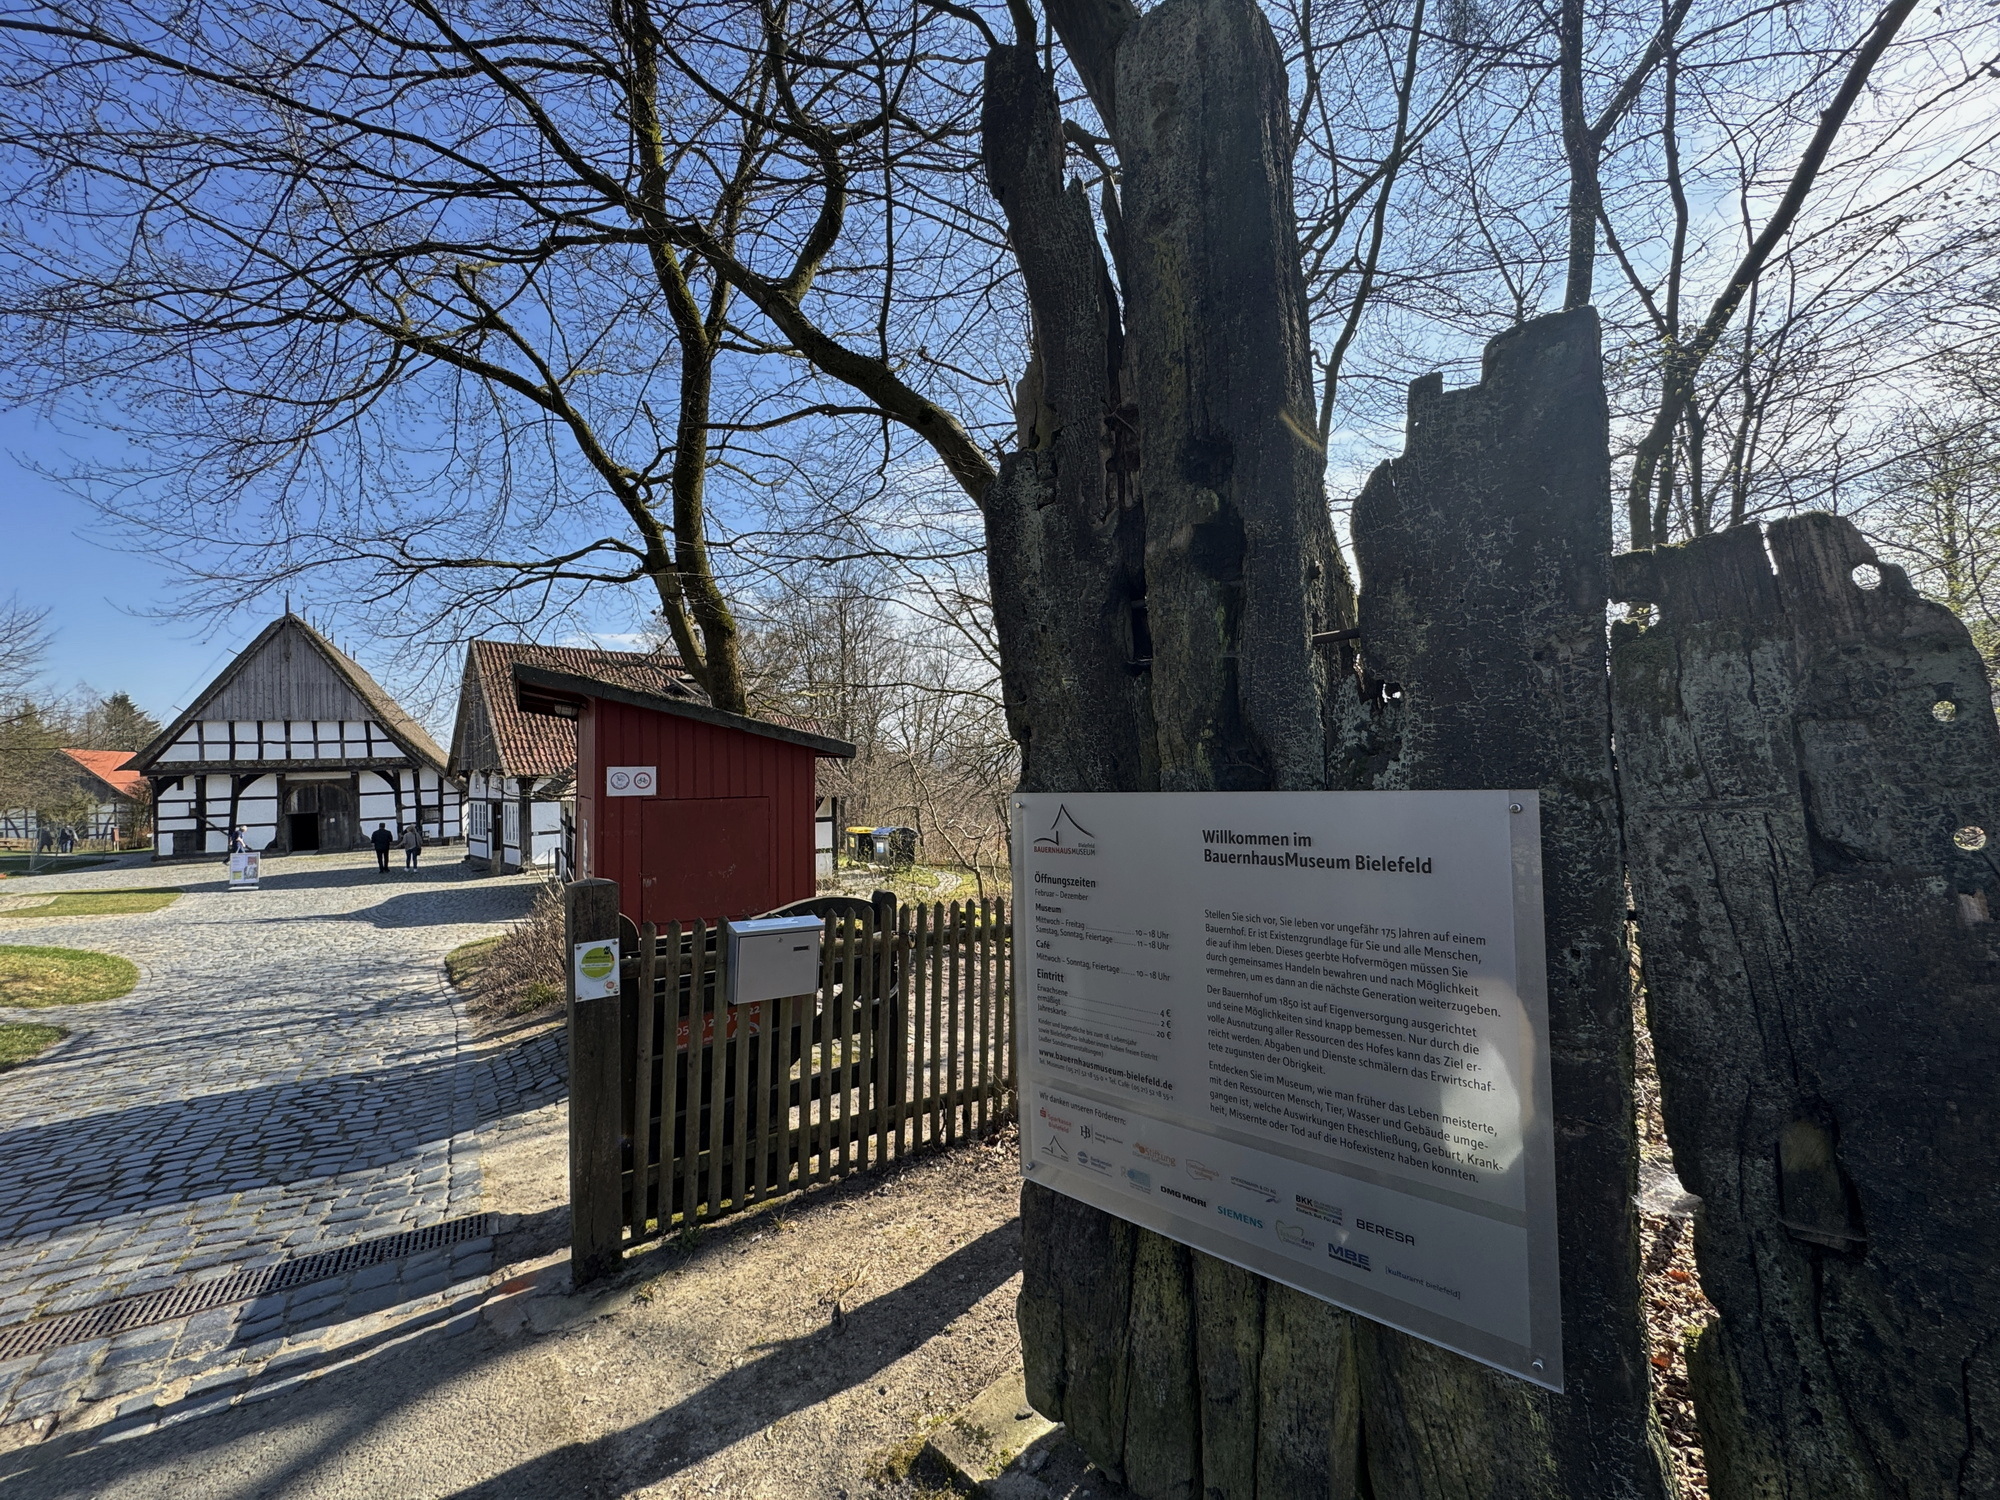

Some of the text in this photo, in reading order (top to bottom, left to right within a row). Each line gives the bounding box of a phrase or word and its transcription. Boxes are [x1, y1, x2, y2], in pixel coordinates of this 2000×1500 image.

[1033, 846, 1096, 856] BAUERNHAUSMUSEUM
[1202, 829, 1312, 847] Willkommen im
[1204, 848, 1432, 874] BauernhausMuseum Bielefeld
[1034, 870, 1096, 888] Öffnungszeiten
[1034, 888, 1089, 901] Februar Dezember
[1035, 902, 1062, 914] Museum
[1065, 918, 1085, 931] Freitag
[1204, 909, 1486, 946] Stellen Sie sich vor, Sie leben vor ungefähr 175 Jahren auf einem
[1035, 939, 1051, 950] Café
[1205, 923, 1482, 965] Bauernhof. Er ist Existenzgrundlage für Sie und alle Menschen,
[1205, 937, 1468, 978] die auf ihm leben. Dieses geerbte Hofvermögen müssen Sie
[1036, 968, 1064, 983] Eintritt
[1206, 951, 1479, 997] durch gemeinsames Handeln bewahren und nach Möglichkeit
[1205, 967, 1501, 1018] vermehren, um es dann an die nächste Generation weiterzugeben.
[1206, 984, 1477, 1038] Der Bauernhof um 1850 ist auf Eigenversorgung ausgerichtet
[1206, 1014, 1482, 1072] volle Ausnutzung aller Ressourcen des Hofes kann das Ziel er-
[1207, 1000, 1480, 1056] und seine Möglichkeiten sind knapp bemessen. Nur durch die
[1038, 1049, 1173, 1091] www.bauernhausmuseum-bielefeld.de
[1208, 1042, 1326, 1075] tete zugunsten der Obrigkeit.
[1208, 1028, 1496, 1092] reicht werden. Abgaben und Dienste schmälern das Erwirtschaf-
[1049, 1094, 1070, 1108] danken
[1070, 1103, 1094, 1115] unseren
[1209, 1060, 1498, 1138] Entdecken Sie im Museum, wie man früher das Leben meisterte,
[1209, 1076, 1489, 1151] mit den Ressourcen Mensch, Tier, Wasser und Gebäude umge-
[1209, 1090, 1504, 1171] gangen ist, welche Auswirkungen Eheschließung, Geburt, Krank-
[1210, 1102, 1479, 1184] heit, Missernte oder Tod auf die Hofexistenz haben konnten.
[1160, 1185, 1182, 1199] DMG
[1182, 1193, 1207, 1208] MORI
[1295, 1194, 1313, 1207] BKK
[1217, 1205, 1264, 1229] SIEMENS
[1356, 1218, 1415, 1246] BERESA
[1328, 1242, 1370, 1267] MBE
